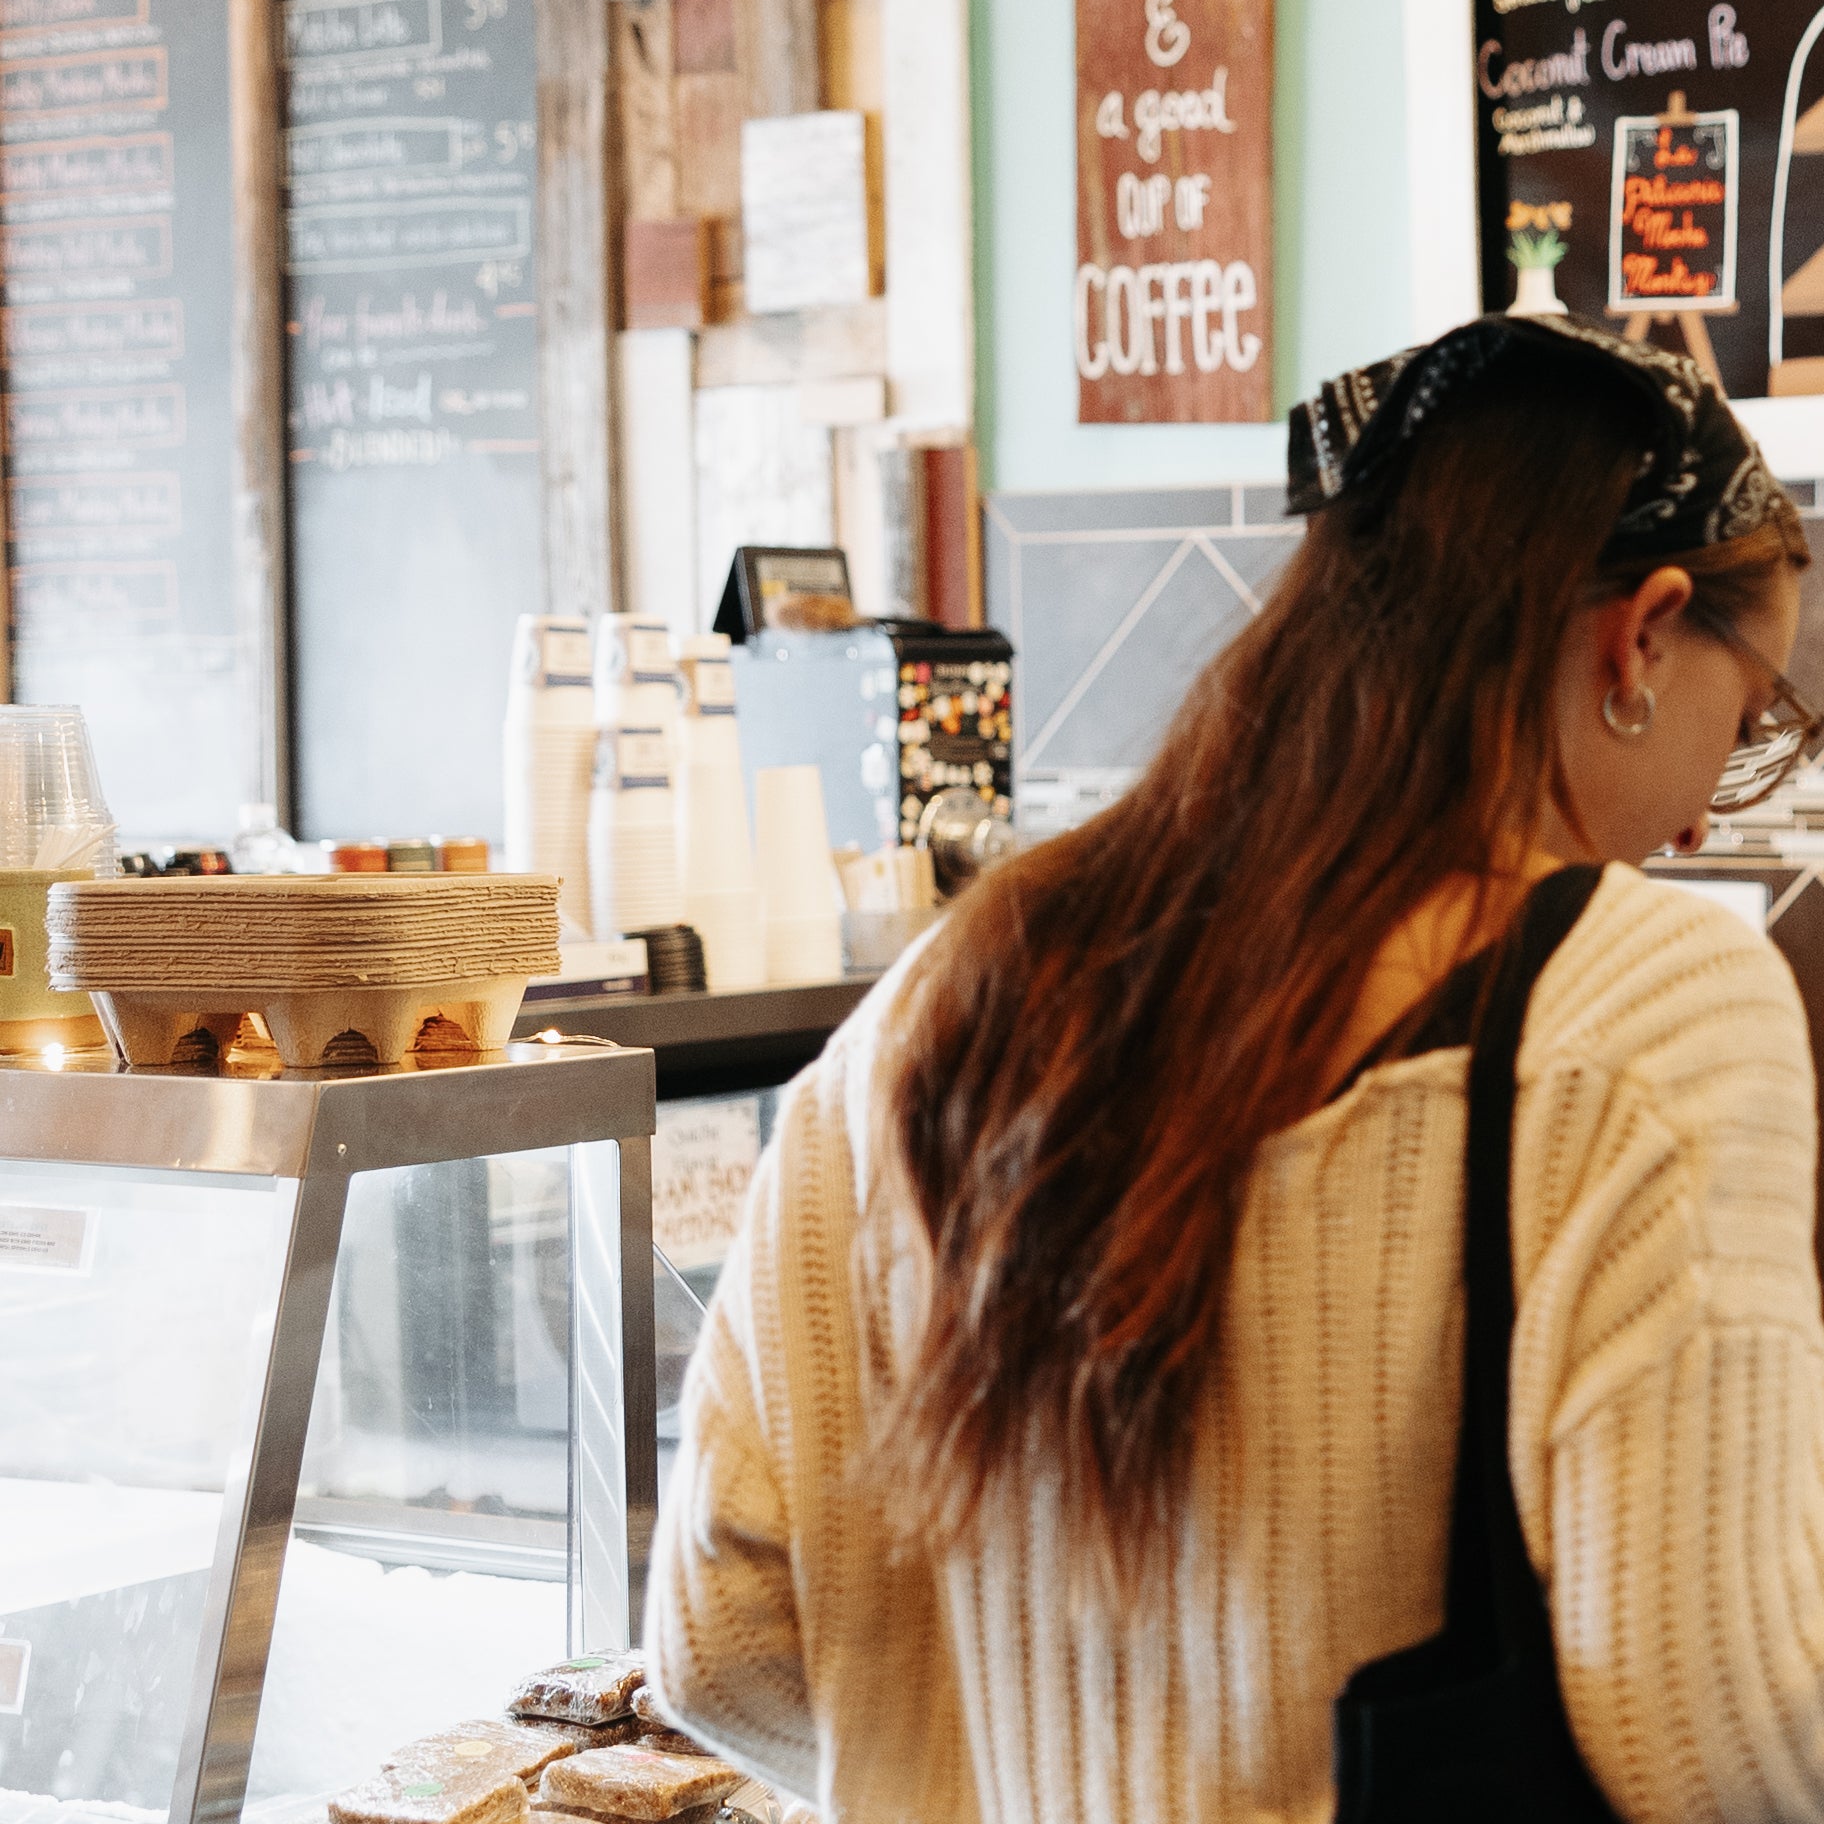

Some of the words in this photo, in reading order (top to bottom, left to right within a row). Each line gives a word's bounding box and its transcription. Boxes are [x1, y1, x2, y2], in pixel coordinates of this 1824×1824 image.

[1601, 18, 1697, 81] Cream
[1707, 2, 1750, 68] Pie
[1095, 90, 1131, 140] a
[1134, 65, 1237, 165] good
